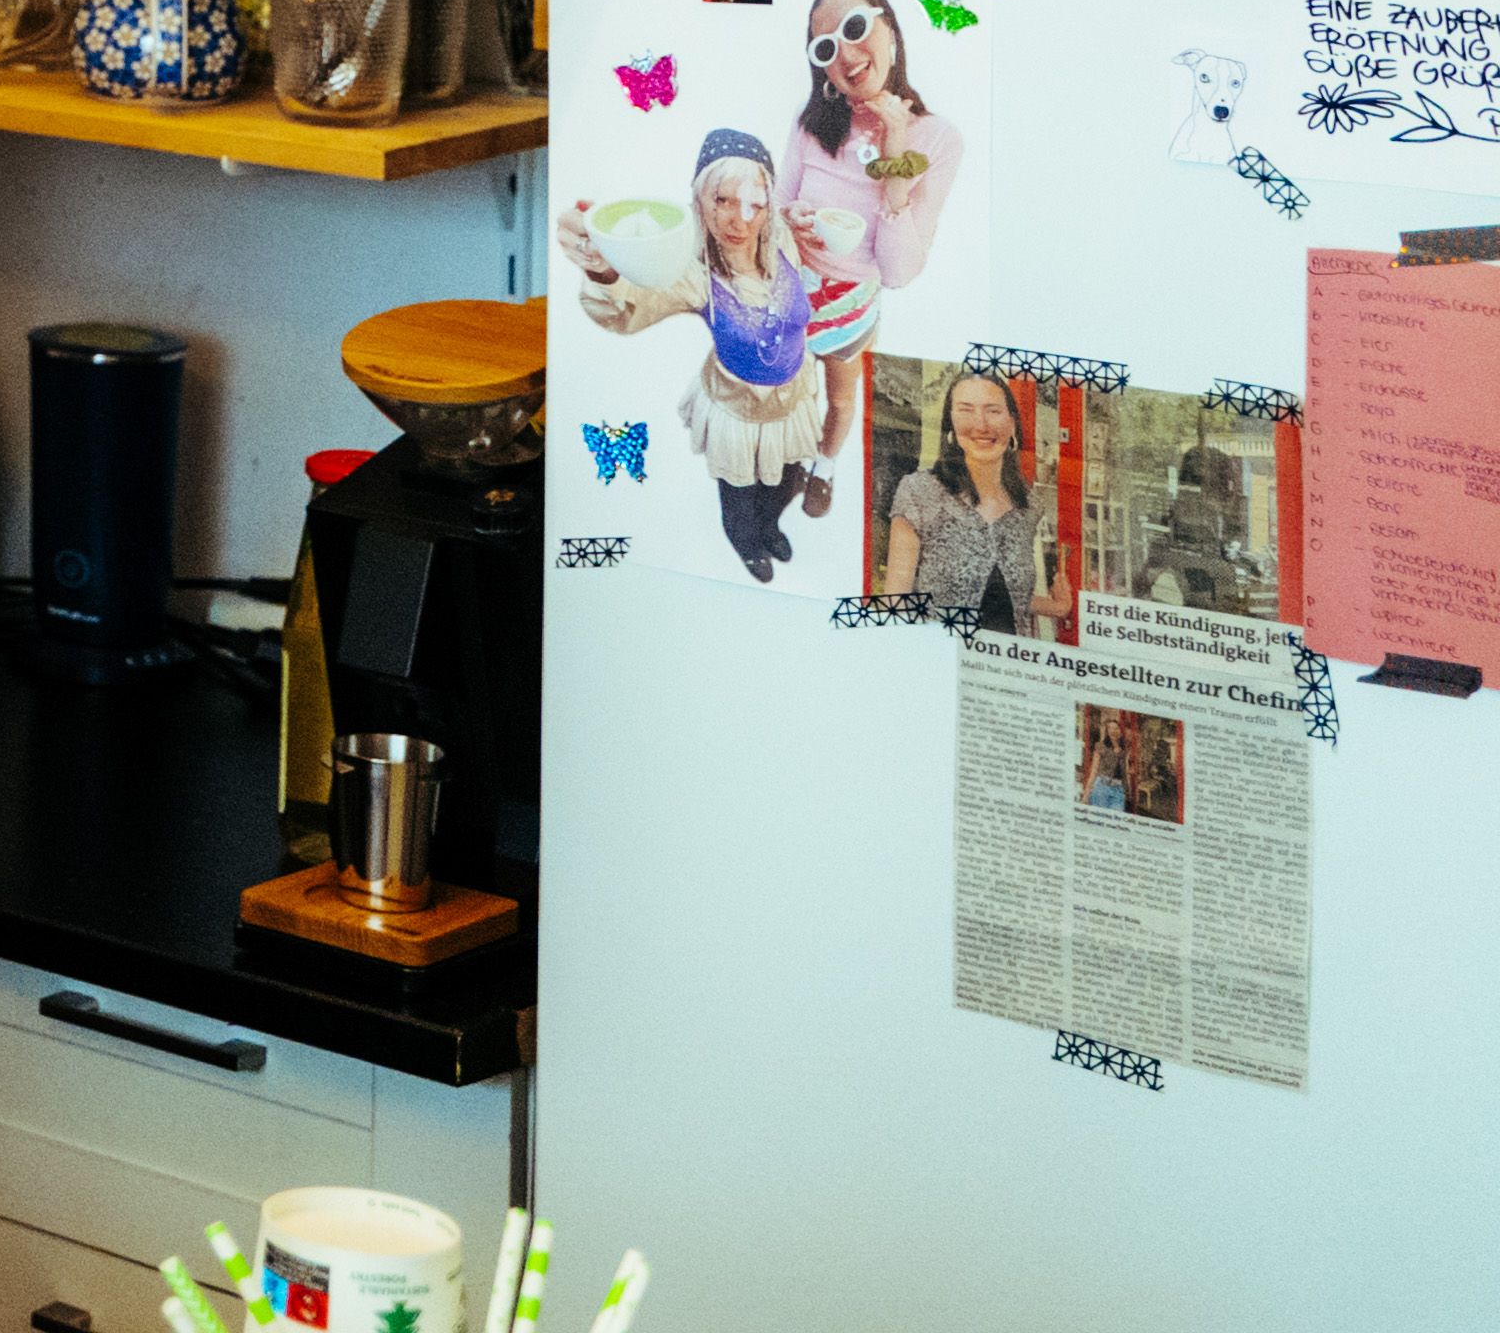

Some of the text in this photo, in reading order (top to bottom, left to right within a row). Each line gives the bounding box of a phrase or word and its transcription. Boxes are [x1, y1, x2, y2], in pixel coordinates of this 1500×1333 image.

[1308, 22, 1491, 62] ERÖFFNUNG
[1388, 2, 1500, 45] ZAUBER
[1085, 599, 1121, 619] Erst
[1123, 604, 1152, 623] die
[1154, 605, 1262, 646] Kündigung,
[1085, 620, 1271, 665] die Selbstständigkeit
[962, 636, 1002, 657] Von
[1006, 642, 1041, 664] der
[1045, 650, 1180, 691] Angestellten
[1185, 679, 1223, 699] zur
[1226, 683, 1304, 713] Chefin
